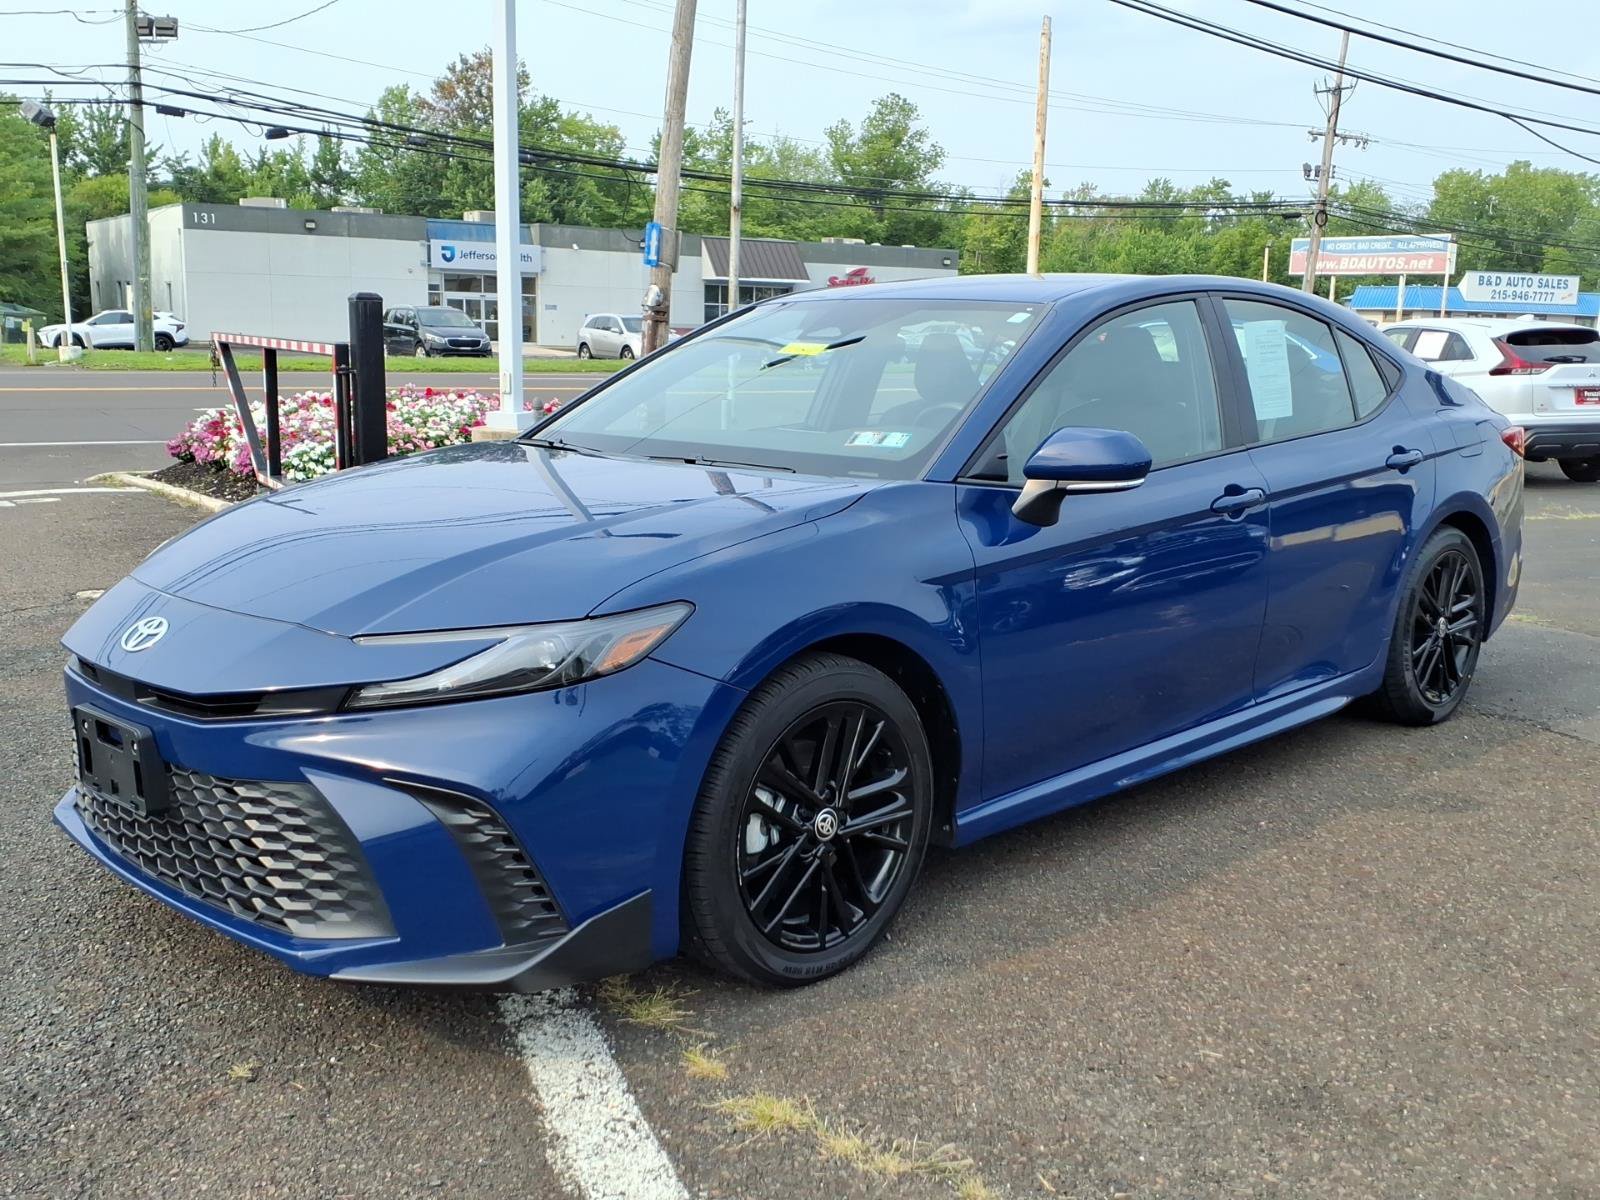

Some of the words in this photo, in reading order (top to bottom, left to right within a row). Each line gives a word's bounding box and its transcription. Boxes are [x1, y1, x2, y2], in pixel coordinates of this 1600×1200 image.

[193, 212, 215, 224] 131
[460, 249, 497, 261] Jefferso
[1306, 256, 1434, 270] ww.BDAUTOS.net
[1506, 276, 1534, 288] AUTO
[1537, 278, 1569, 290] SALES
